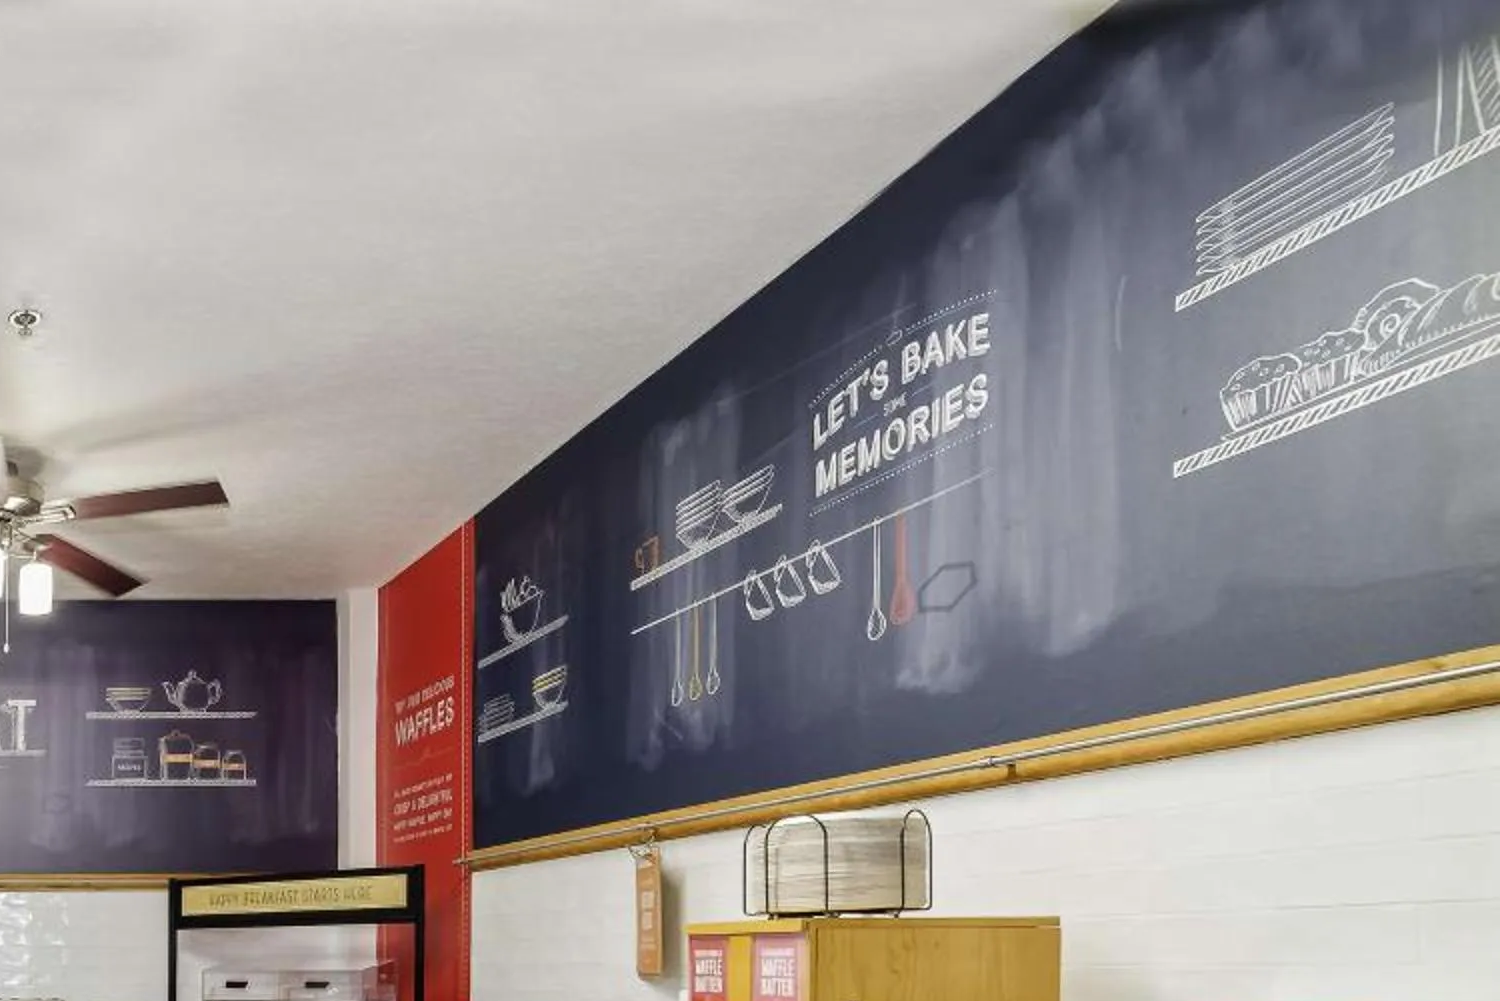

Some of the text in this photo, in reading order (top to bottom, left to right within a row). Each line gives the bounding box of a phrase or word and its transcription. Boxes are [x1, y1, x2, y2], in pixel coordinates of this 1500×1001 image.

[813, 313, 991, 450] LET'S BAKE
[815, 373, 989, 498] MEMORIES
[395, 696, 455, 747] WAFFLES
[694, 958, 723, 976] WAFFLE
[760, 958, 796, 977] WAFFLE
[760, 977, 796, 996] BATTER
